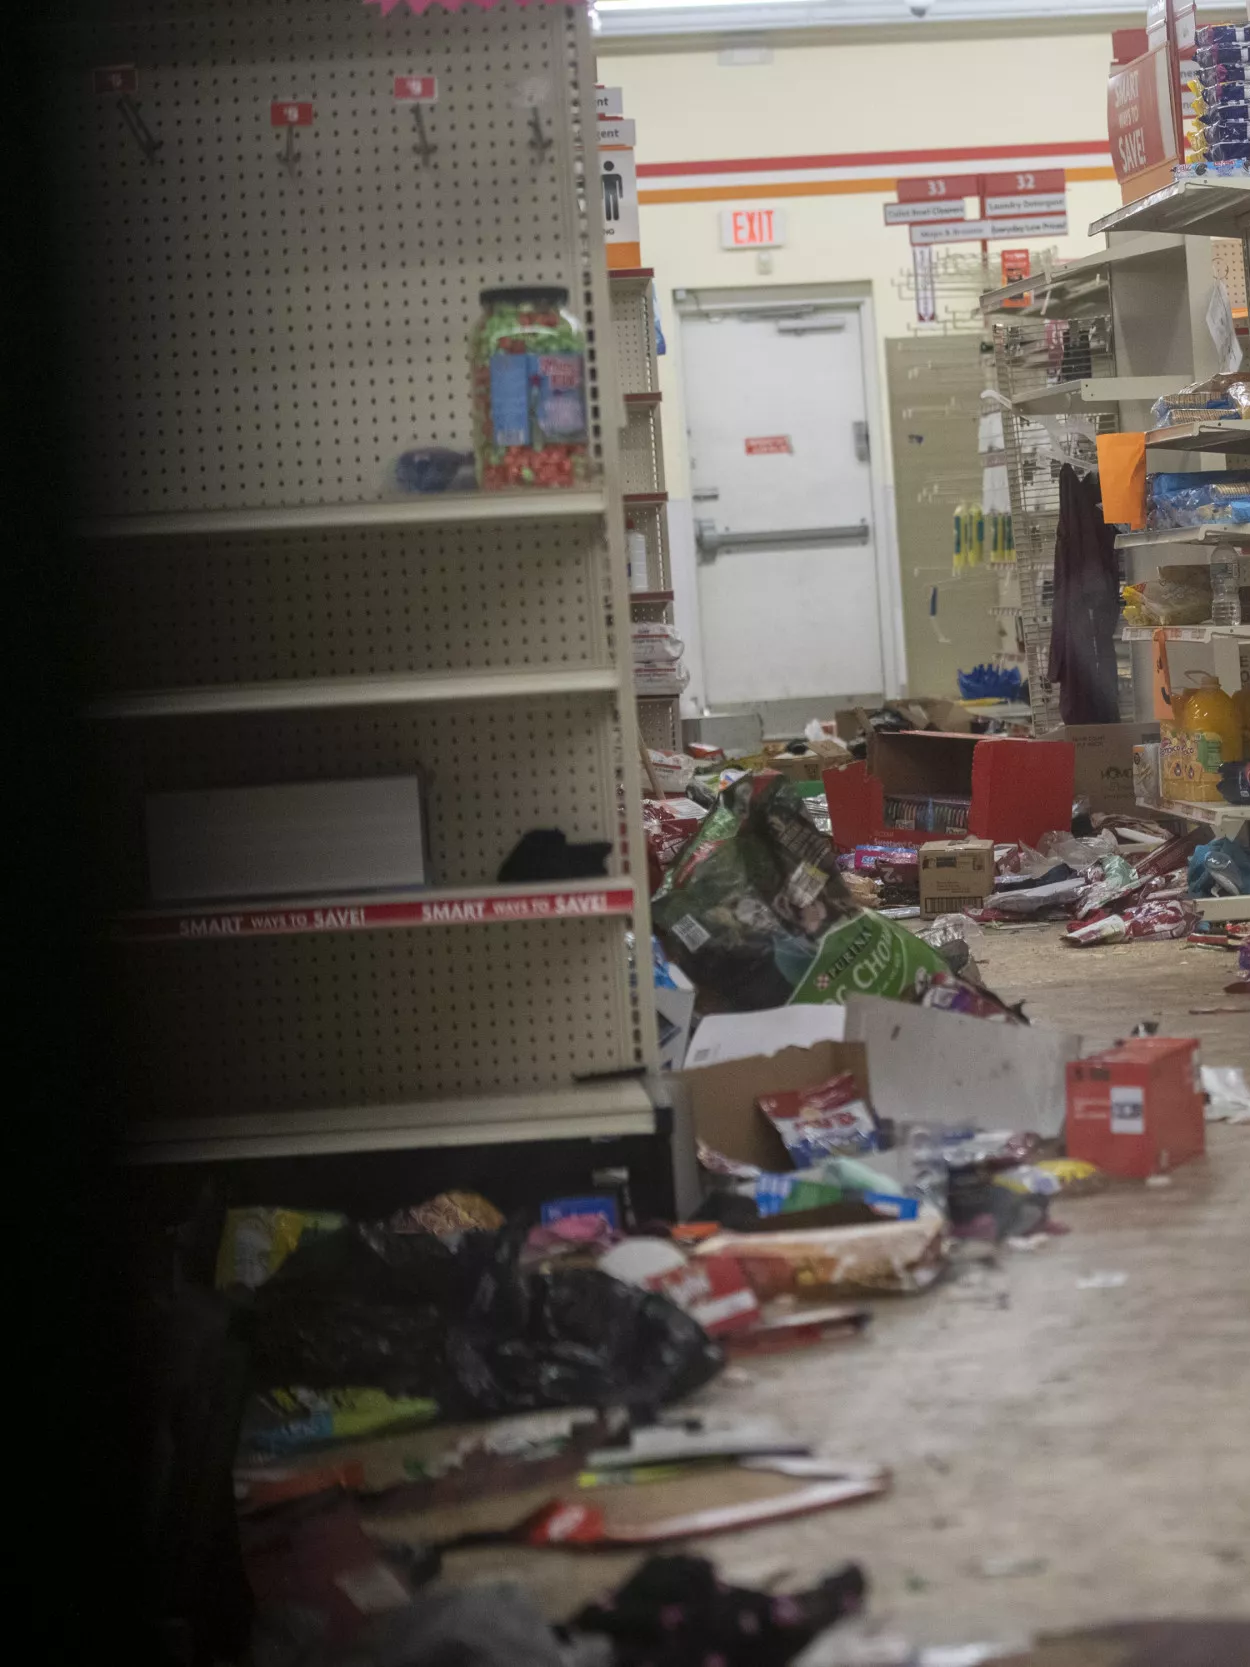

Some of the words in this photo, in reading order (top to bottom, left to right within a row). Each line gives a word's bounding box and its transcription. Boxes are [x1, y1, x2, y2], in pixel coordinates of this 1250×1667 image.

[1118, 126, 1147, 173] SAVE!
[927, 179, 946, 196] 33
[1016, 174, 1036, 190] 32
[731, 209, 775, 244] EXIT
[421, 903, 486, 922] SMART
[492, 901, 528, 916] WAYS
[531, 900, 549, 914] TO
[554, 894, 608, 914] SAVE!
[180, 915, 243, 936] SMART
[250, 915, 287, 930] WAYS
[289, 913, 307, 928] TO
[313, 909, 366, 929] SAVE!
[828, 926, 873, 980] PURINA
